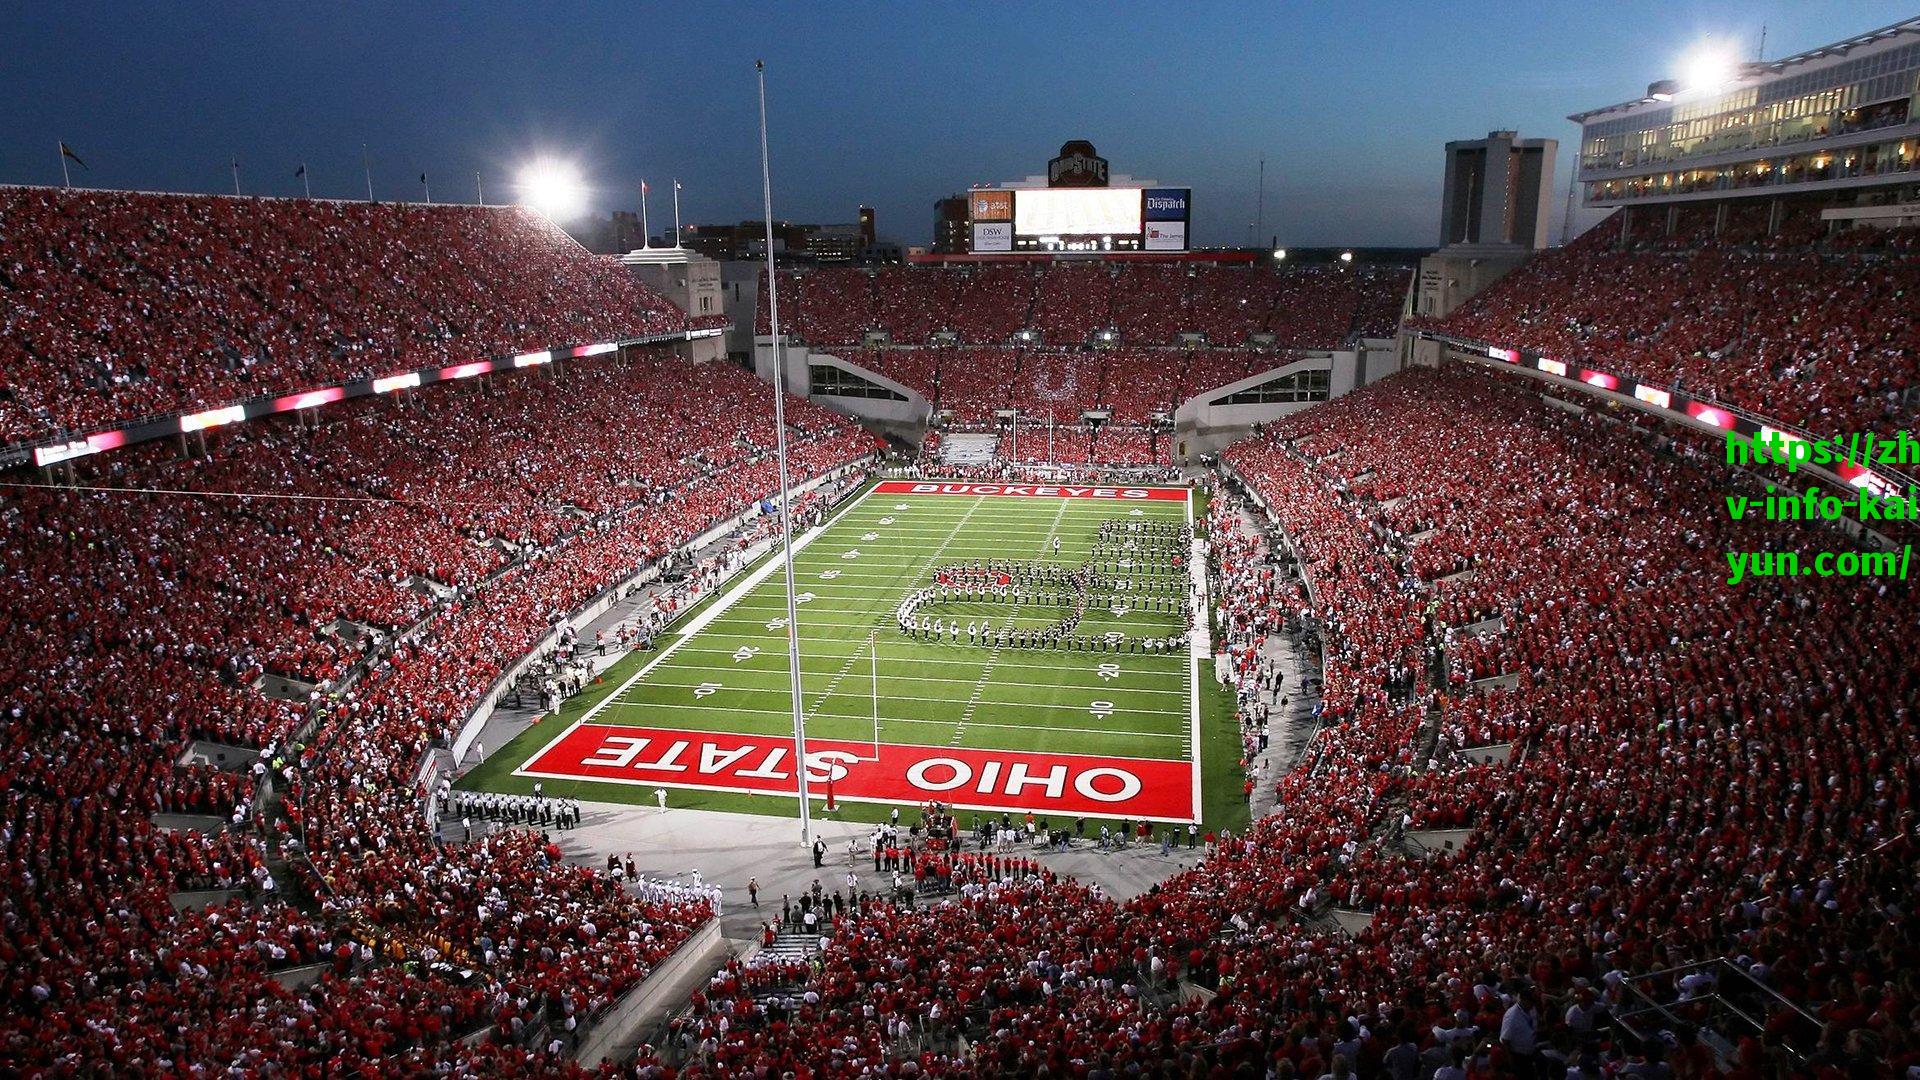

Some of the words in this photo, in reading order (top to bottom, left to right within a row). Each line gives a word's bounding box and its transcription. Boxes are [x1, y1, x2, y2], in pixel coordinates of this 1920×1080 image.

[1072, 152, 1106, 181] STATE
[1147, 197, 1185, 210] Dispatch
[983, 227, 1003, 236] DSW
[911, 484, 1150, 499] BUCKEYES
[732, 646, 760, 660] 20
[1098, 663, 1120, 678] 20
[693, 682, 723, 696] 10
[1089, 701, 1114, 715] 10
[580, 736, 860, 783] STATE
[905, 757, 1143, 803] OHIO
